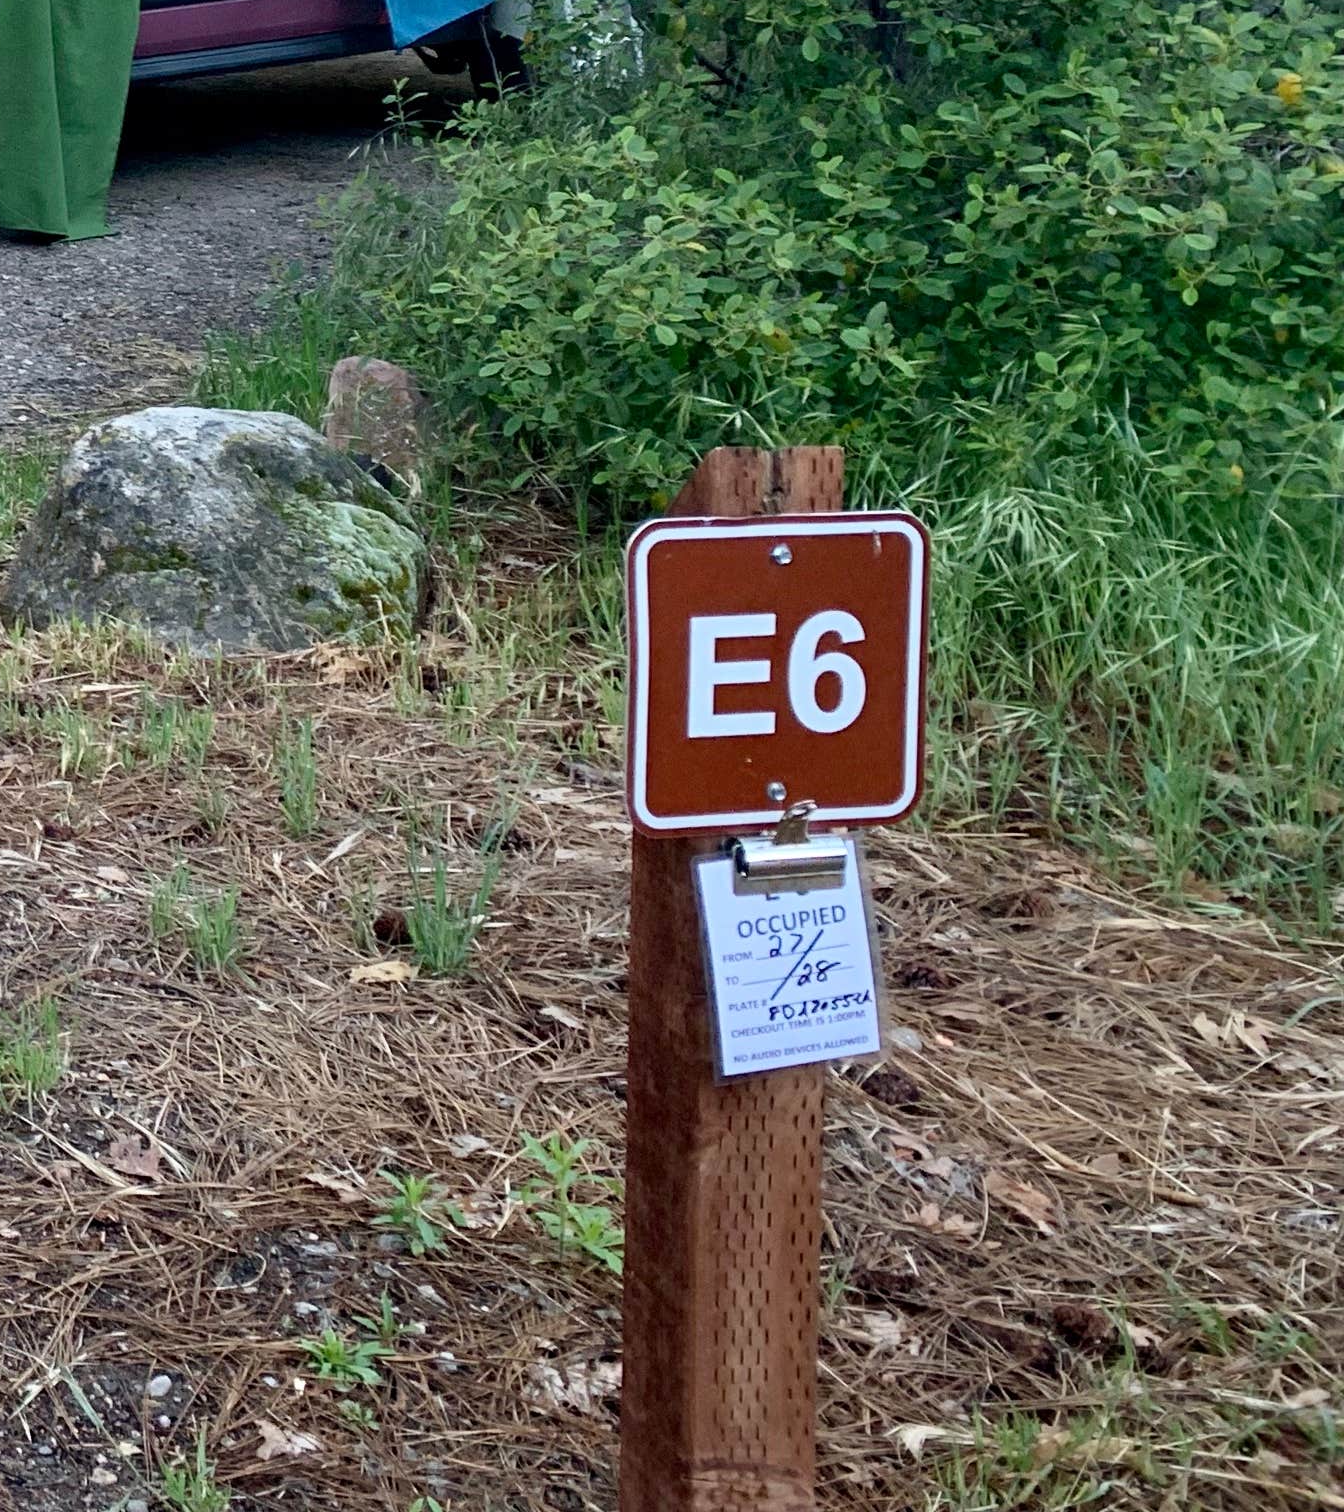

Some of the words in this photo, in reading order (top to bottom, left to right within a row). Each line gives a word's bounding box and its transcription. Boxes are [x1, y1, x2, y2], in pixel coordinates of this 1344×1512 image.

[687, 609, 867, 739] E6
[737, 904, 847, 938] OCCUPIED
[722, 951, 753, 963] FROM
[725, 976, 740, 986] TO
[728, 999, 760, 1012] PLATE
[730, 1022, 786, 1039] CHECKOUT
[789, 1019, 812, 1031] TIME
[815, 1017, 825, 1026] IS
[733, 1054, 749, 1063] NO
[751, 1048, 782, 1061] AUDIO
[784, 1042, 822, 1057] DEVICES
[823, 1035, 869, 1050] ALLOWED
